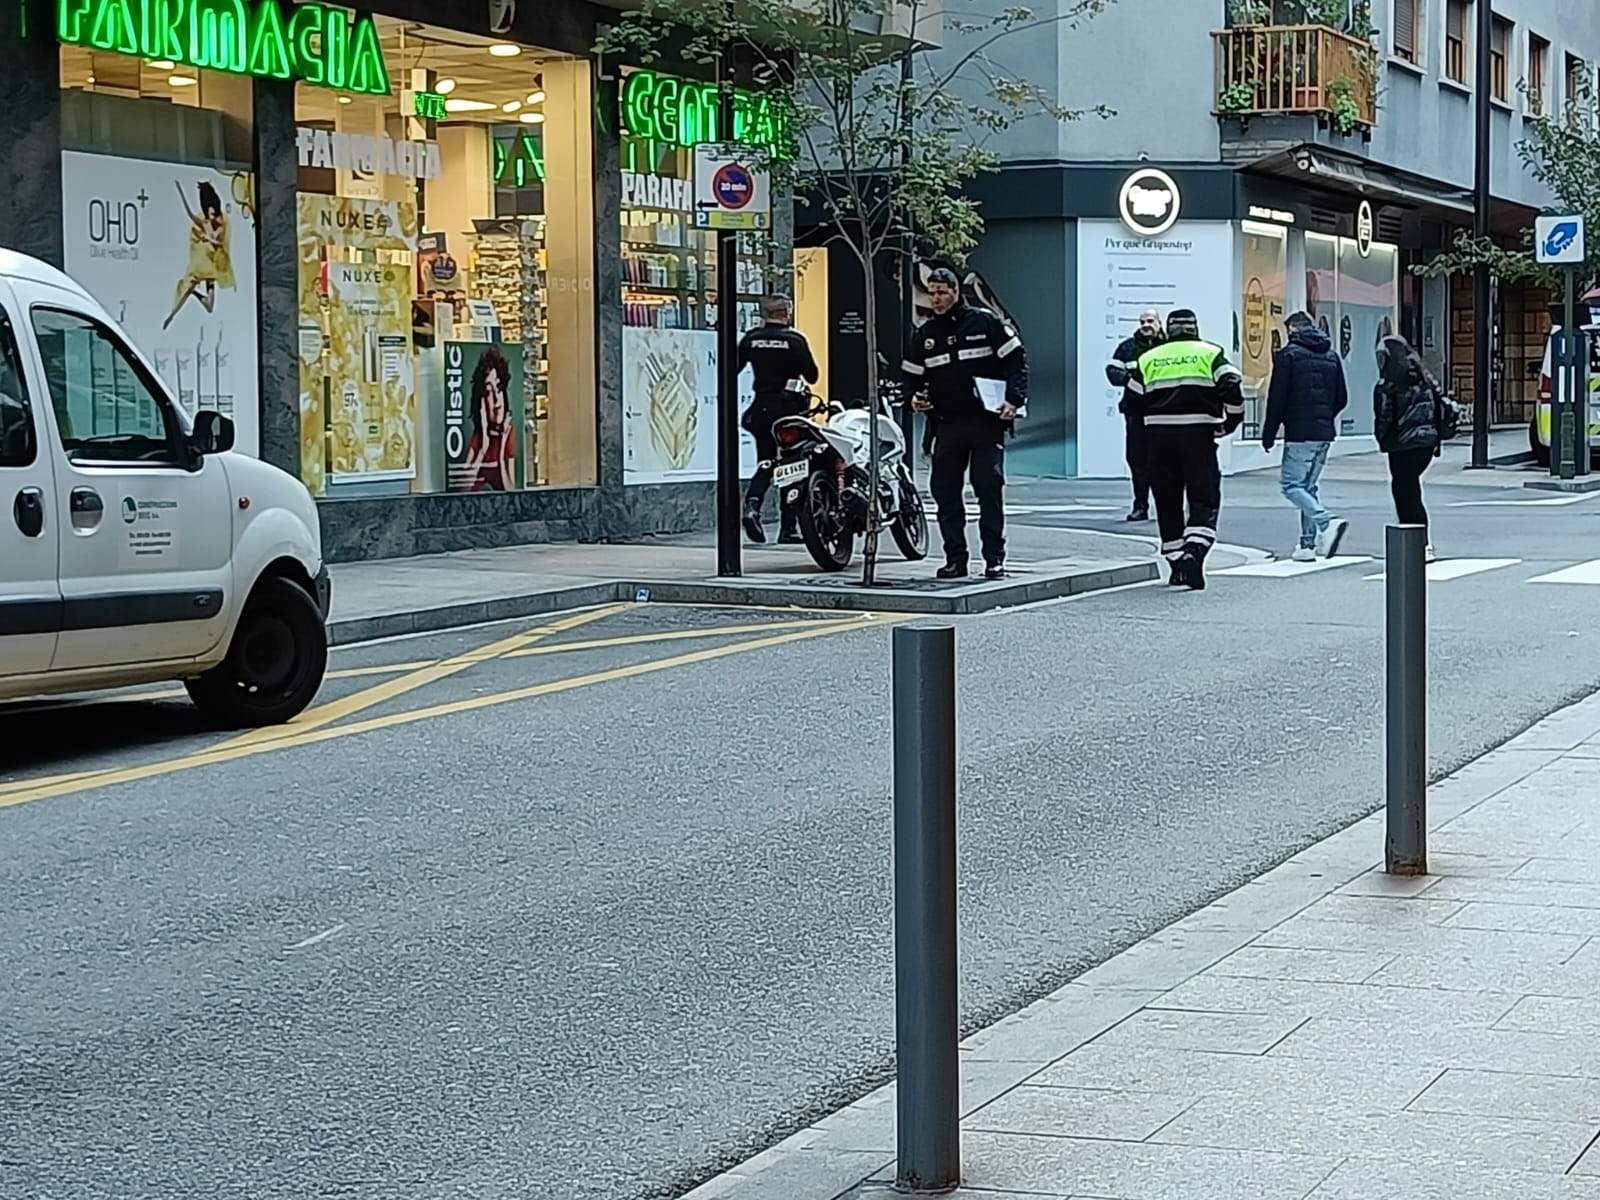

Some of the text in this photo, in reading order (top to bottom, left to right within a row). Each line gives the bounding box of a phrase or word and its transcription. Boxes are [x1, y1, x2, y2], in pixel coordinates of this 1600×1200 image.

[59, 0, 390, 94] FARMACIA
[342, 270, 382, 283] NUXE
[446, 345, 464, 458] Olistic
